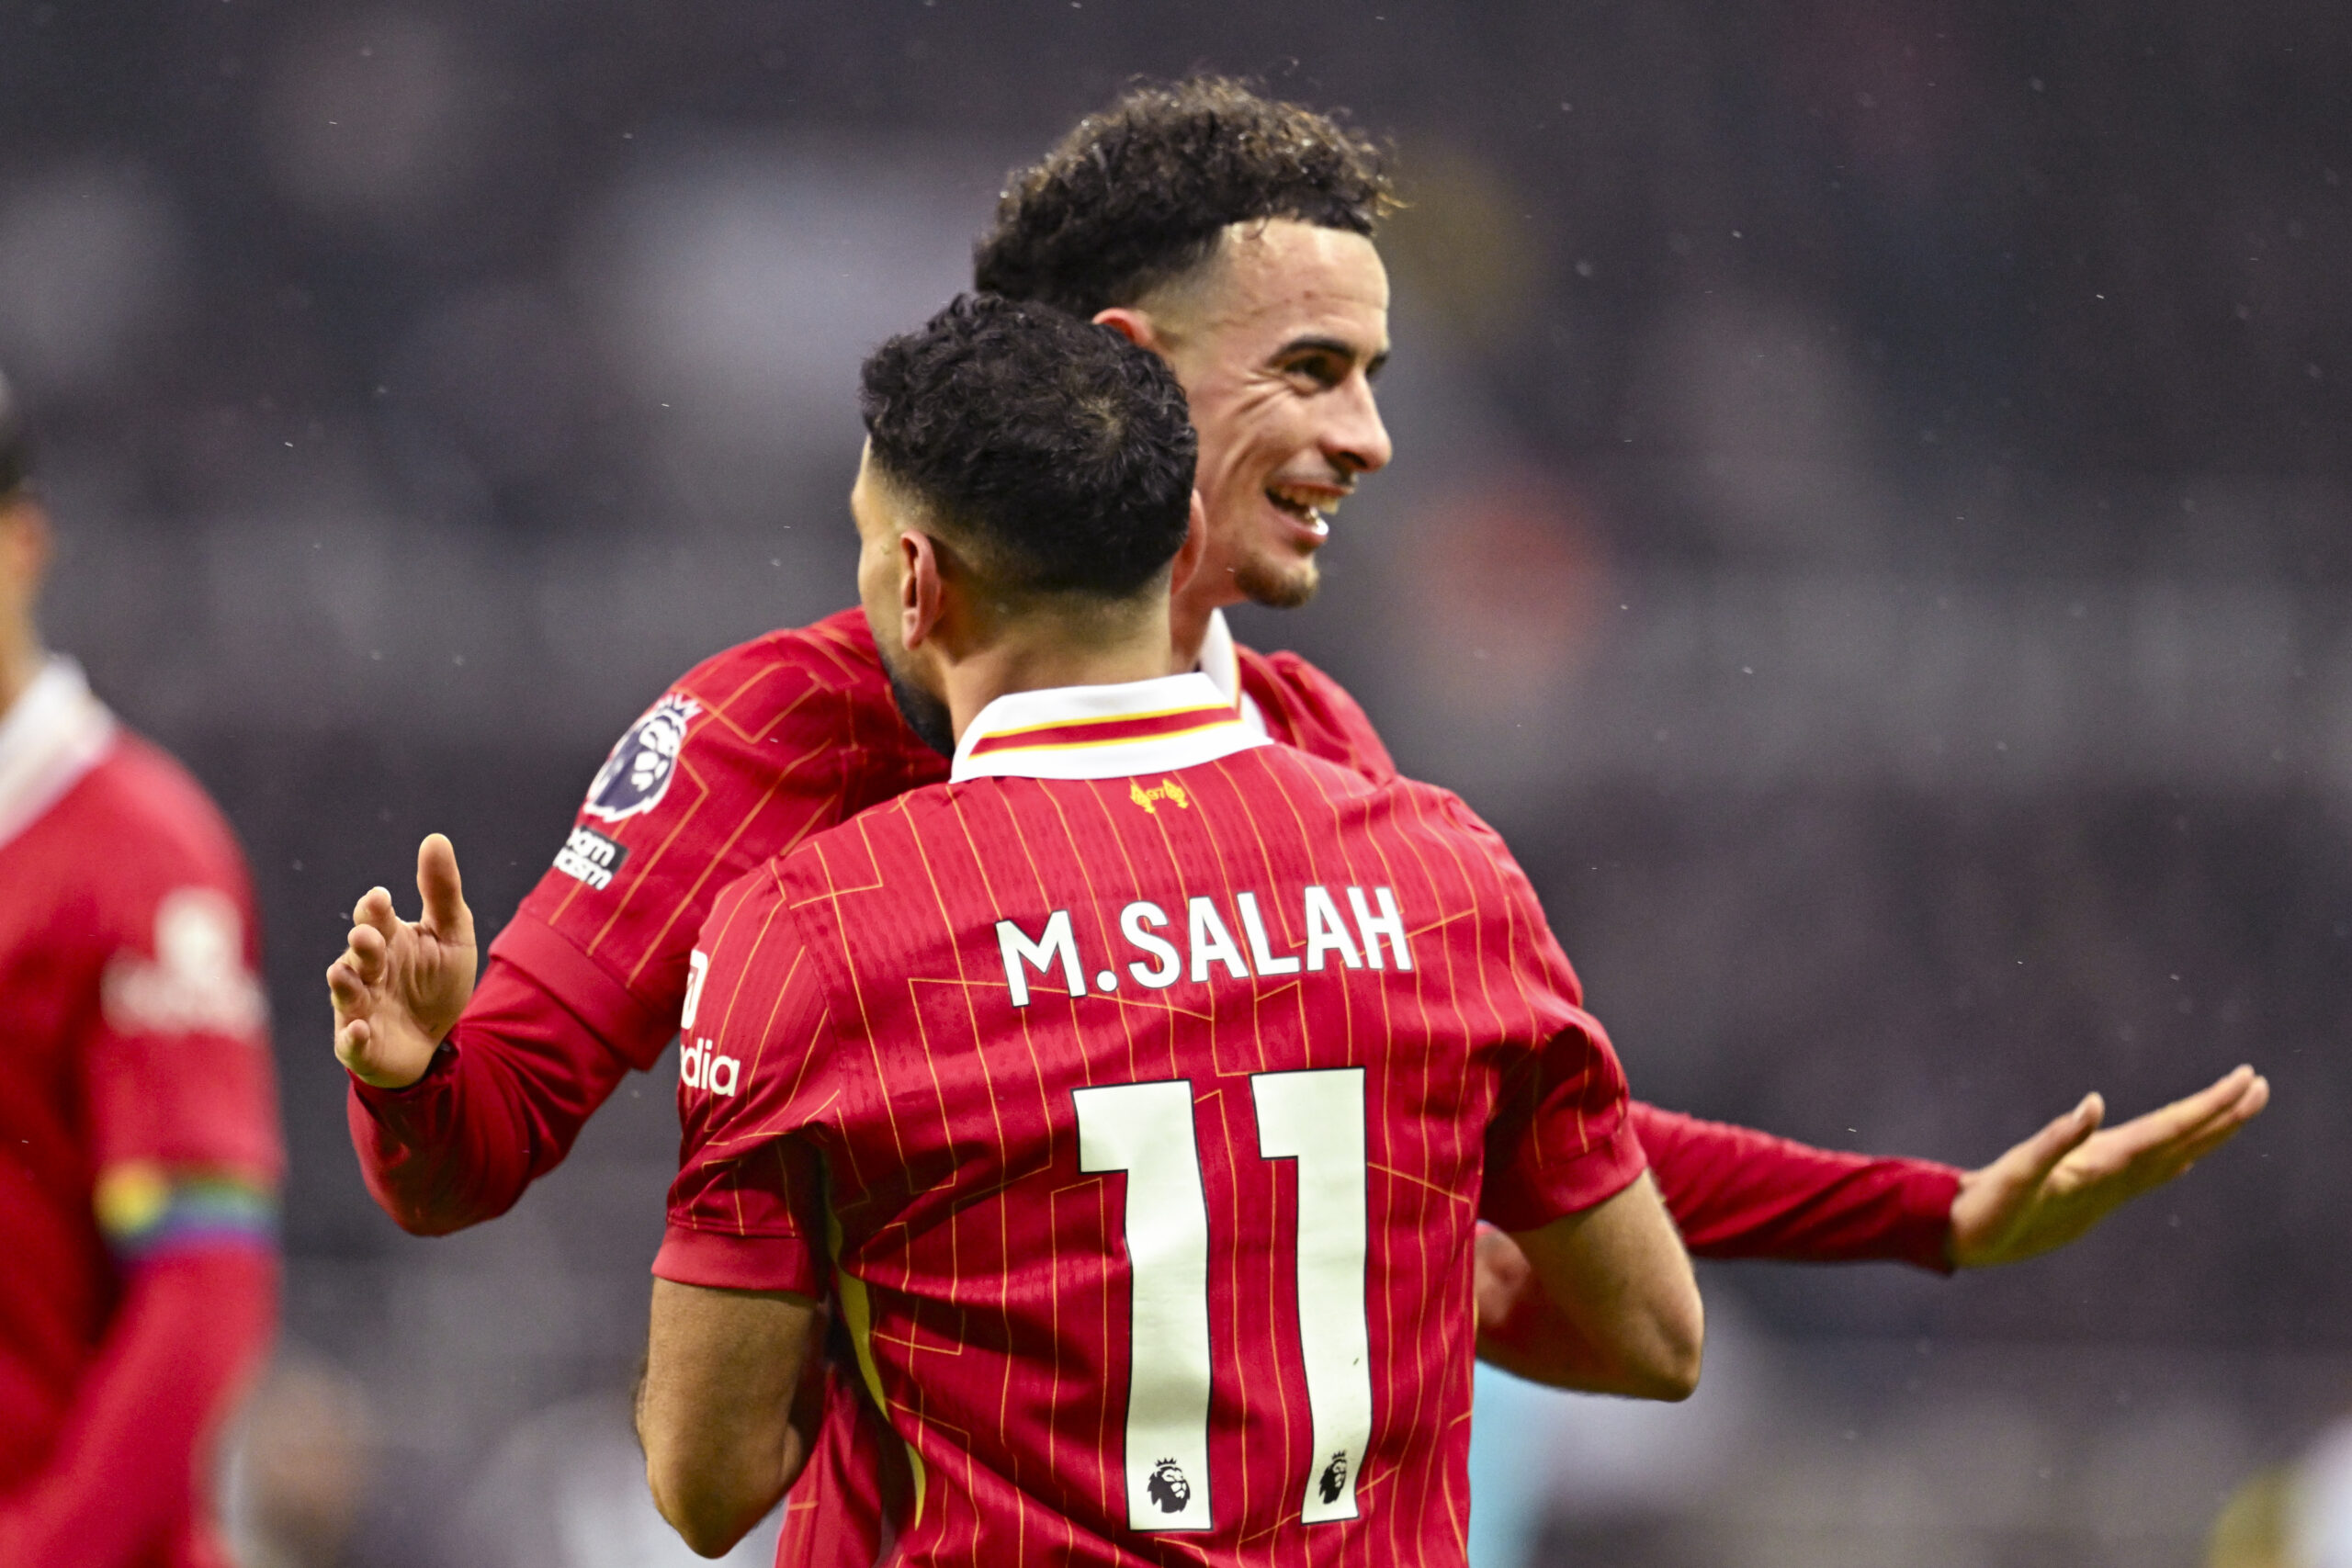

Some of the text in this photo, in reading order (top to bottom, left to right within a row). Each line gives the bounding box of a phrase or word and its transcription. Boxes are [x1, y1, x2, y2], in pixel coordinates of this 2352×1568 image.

[995, 885, 1413, 1008] M.SALAH
[681, 1037, 741, 1097] dia
[1070, 1066, 1374, 1531] 11
